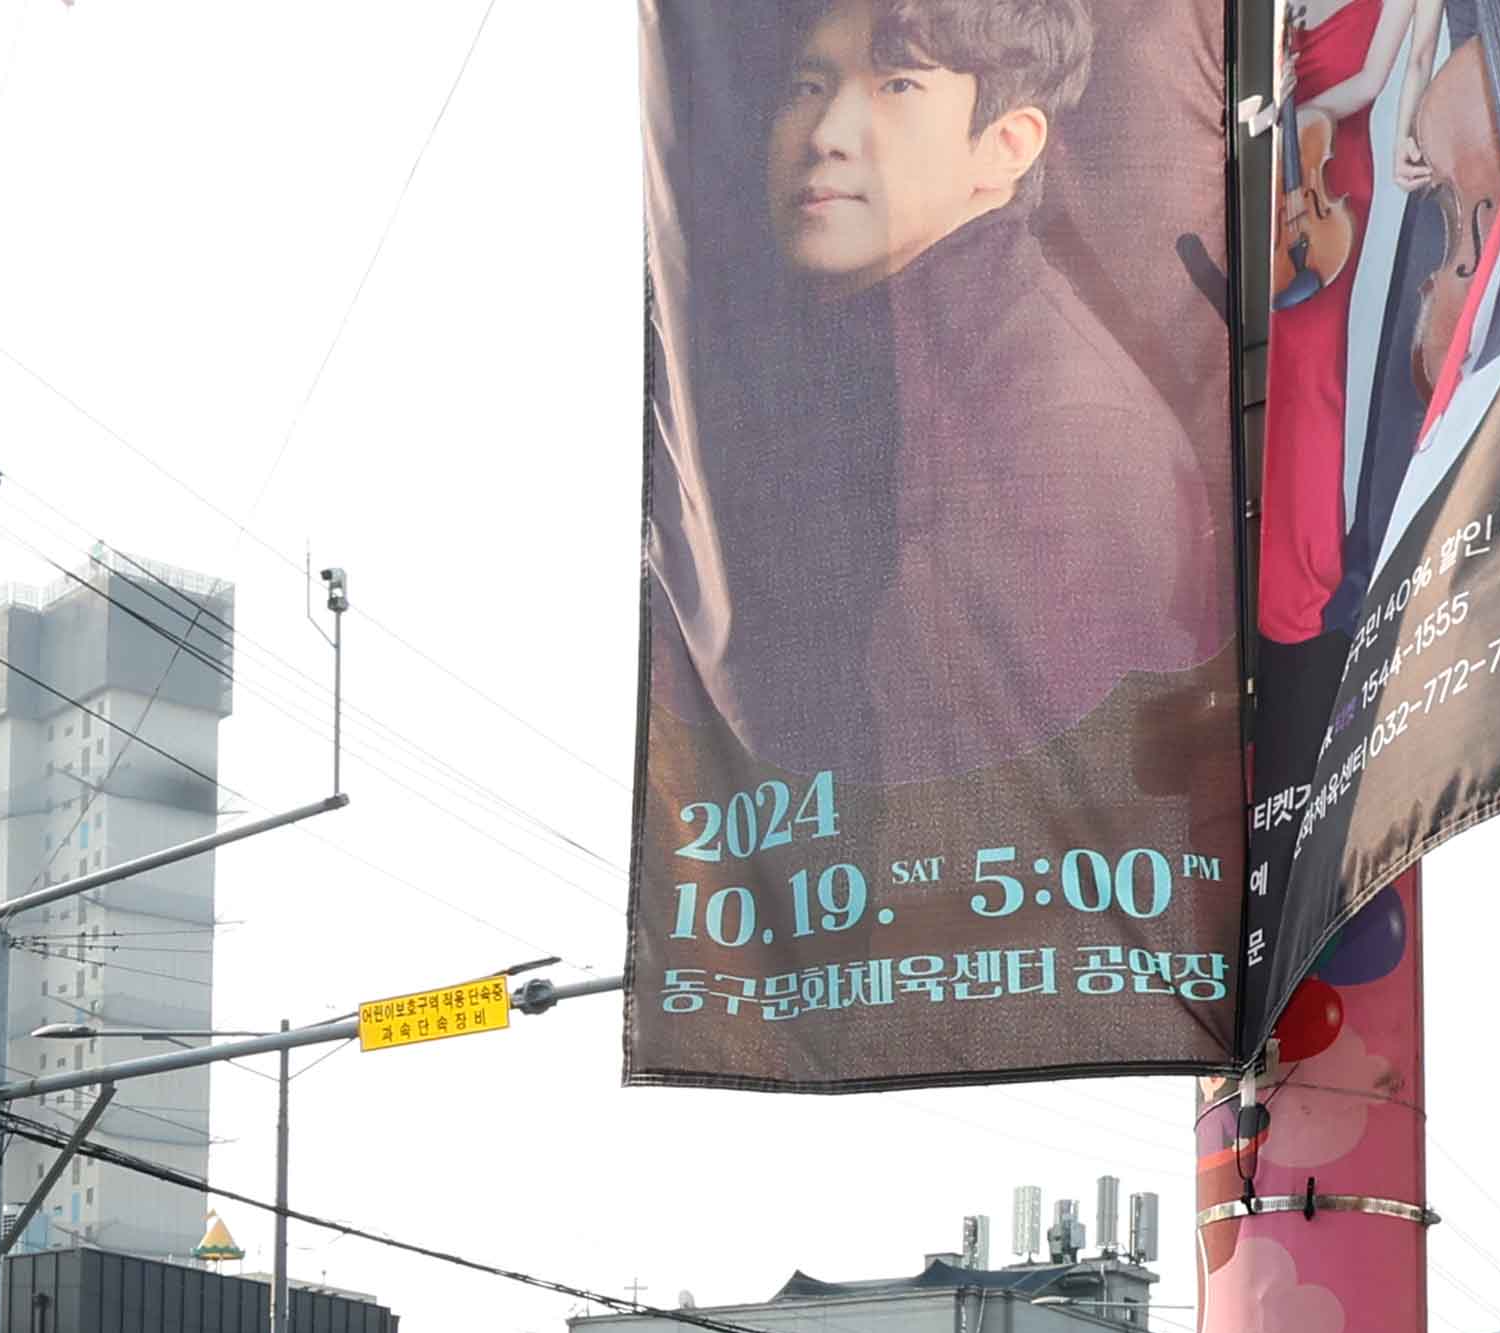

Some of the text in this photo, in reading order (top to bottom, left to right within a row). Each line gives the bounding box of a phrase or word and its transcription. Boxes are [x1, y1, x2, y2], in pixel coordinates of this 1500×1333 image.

[1384, 557, 1432, 622] 40%
[1440, 515, 1491, 575] 할인
[1362, 592, 1470, 708] 1544-1555
[674, 770, 839, 862] 2024
[668, 847, 1221, 948] 10.19. SAT 5:00 PM
[661, 945, 1229, 1022] 동구문화체육센터 공연장
